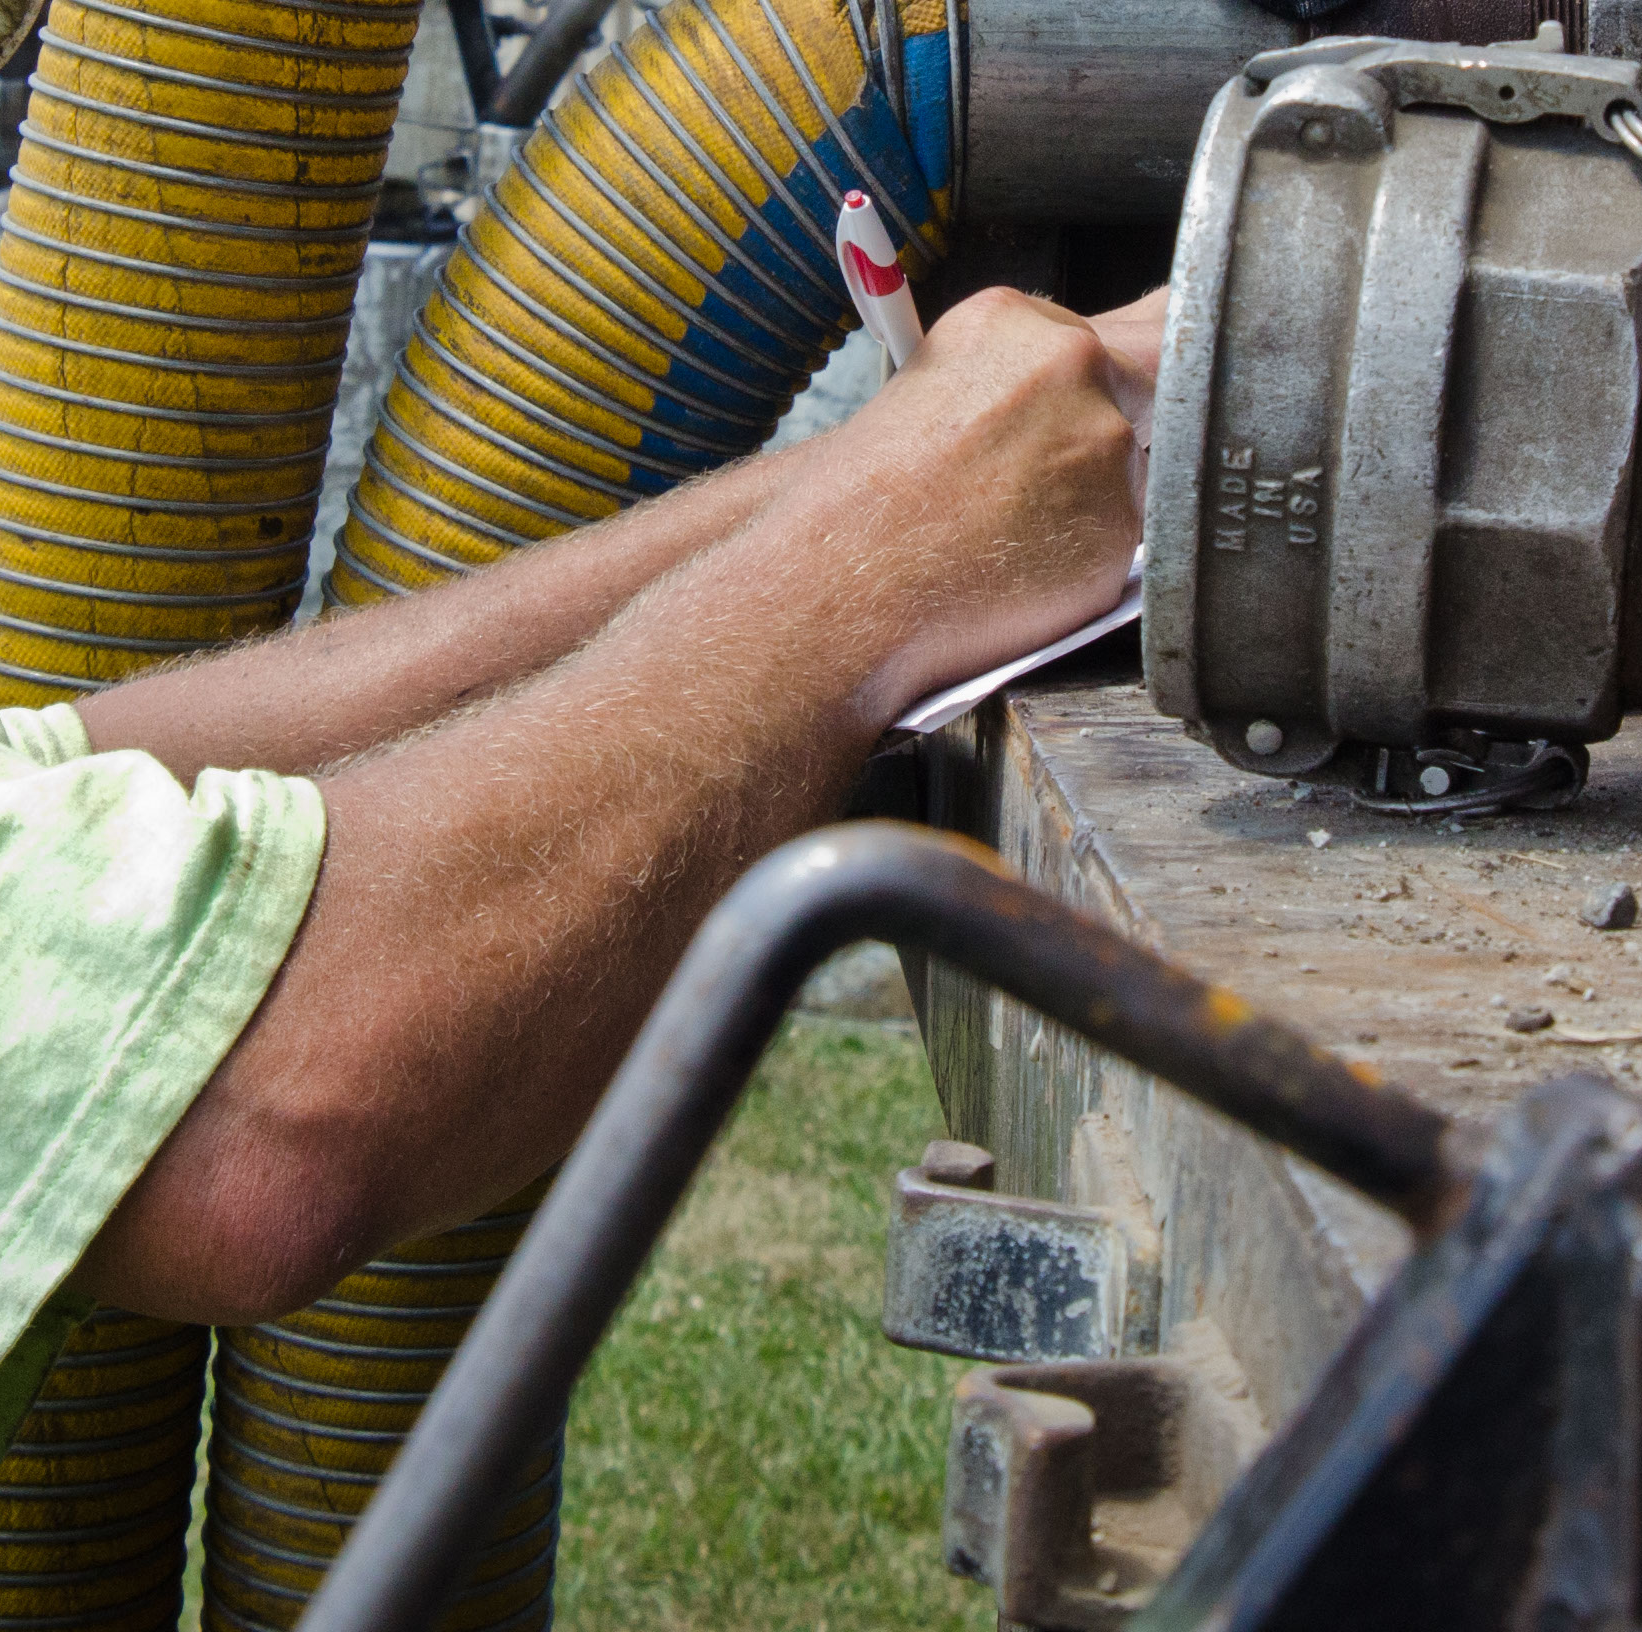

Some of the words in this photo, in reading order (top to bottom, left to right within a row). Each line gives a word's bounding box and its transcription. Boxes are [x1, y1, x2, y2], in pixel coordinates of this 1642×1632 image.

[1213, 447, 1254, 552] MADE
[1252, 479, 1286, 519] IN
[1288, 466, 1324, 545] USA
